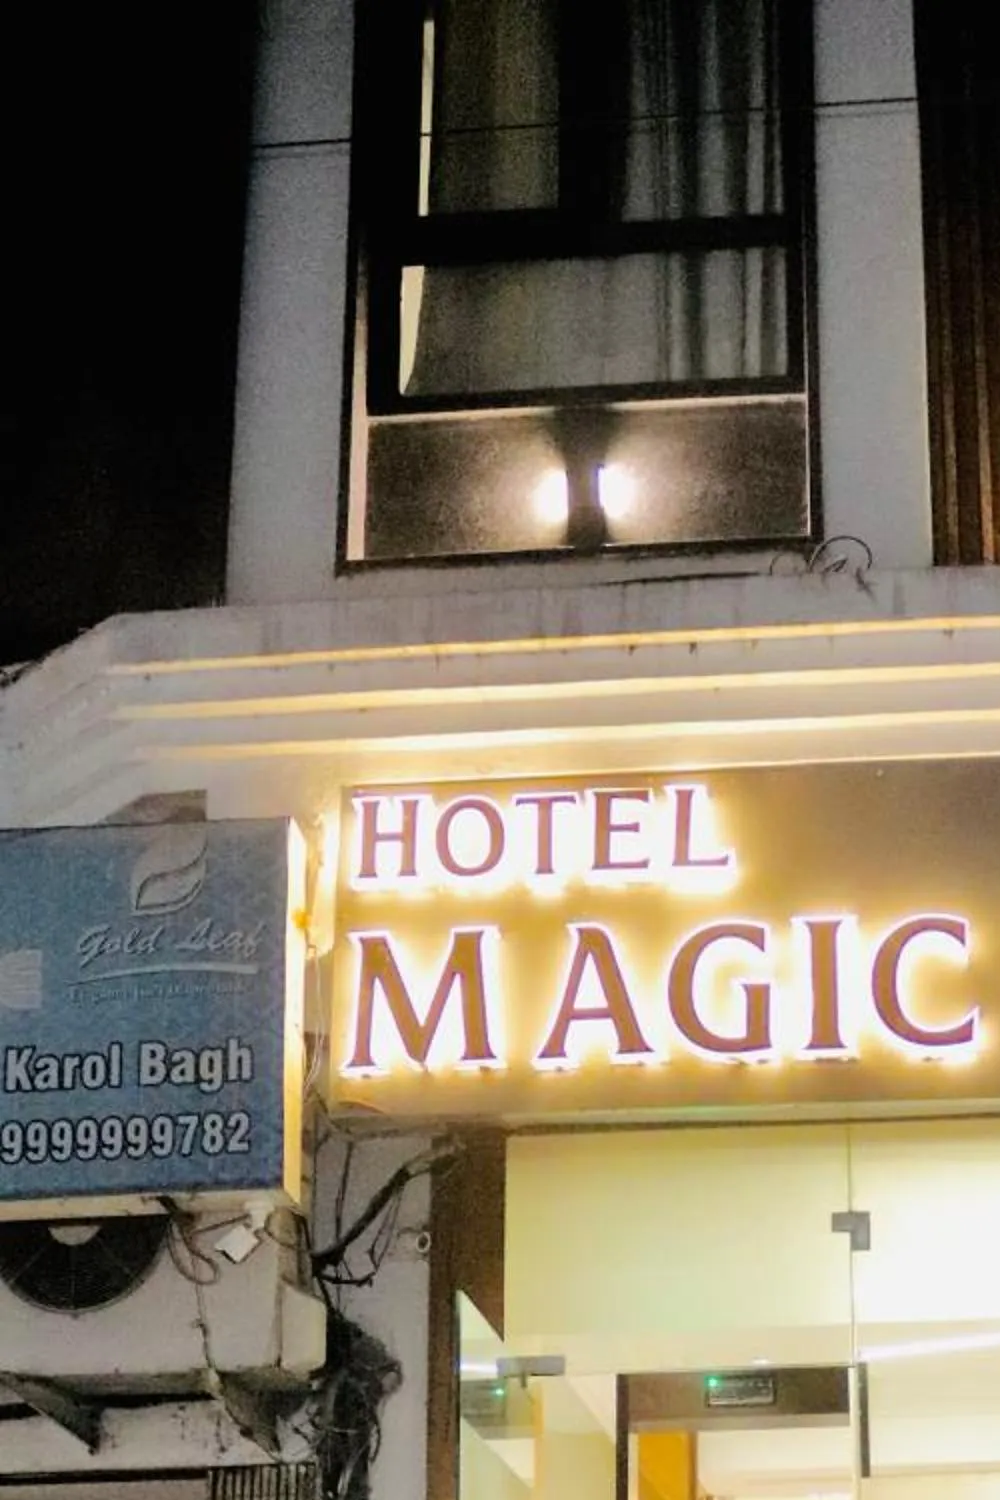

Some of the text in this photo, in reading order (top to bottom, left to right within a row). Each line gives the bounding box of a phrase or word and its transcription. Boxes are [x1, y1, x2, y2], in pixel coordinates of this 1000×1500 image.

[353, 786, 731, 879] HOTEL
[77, 917, 267, 968] Gold Leaf
[346, 915, 976, 1068] MAGIC
[4, 1035, 254, 1094] Karol Bagh
[0, 1111, 251, 1165] 9999999782
